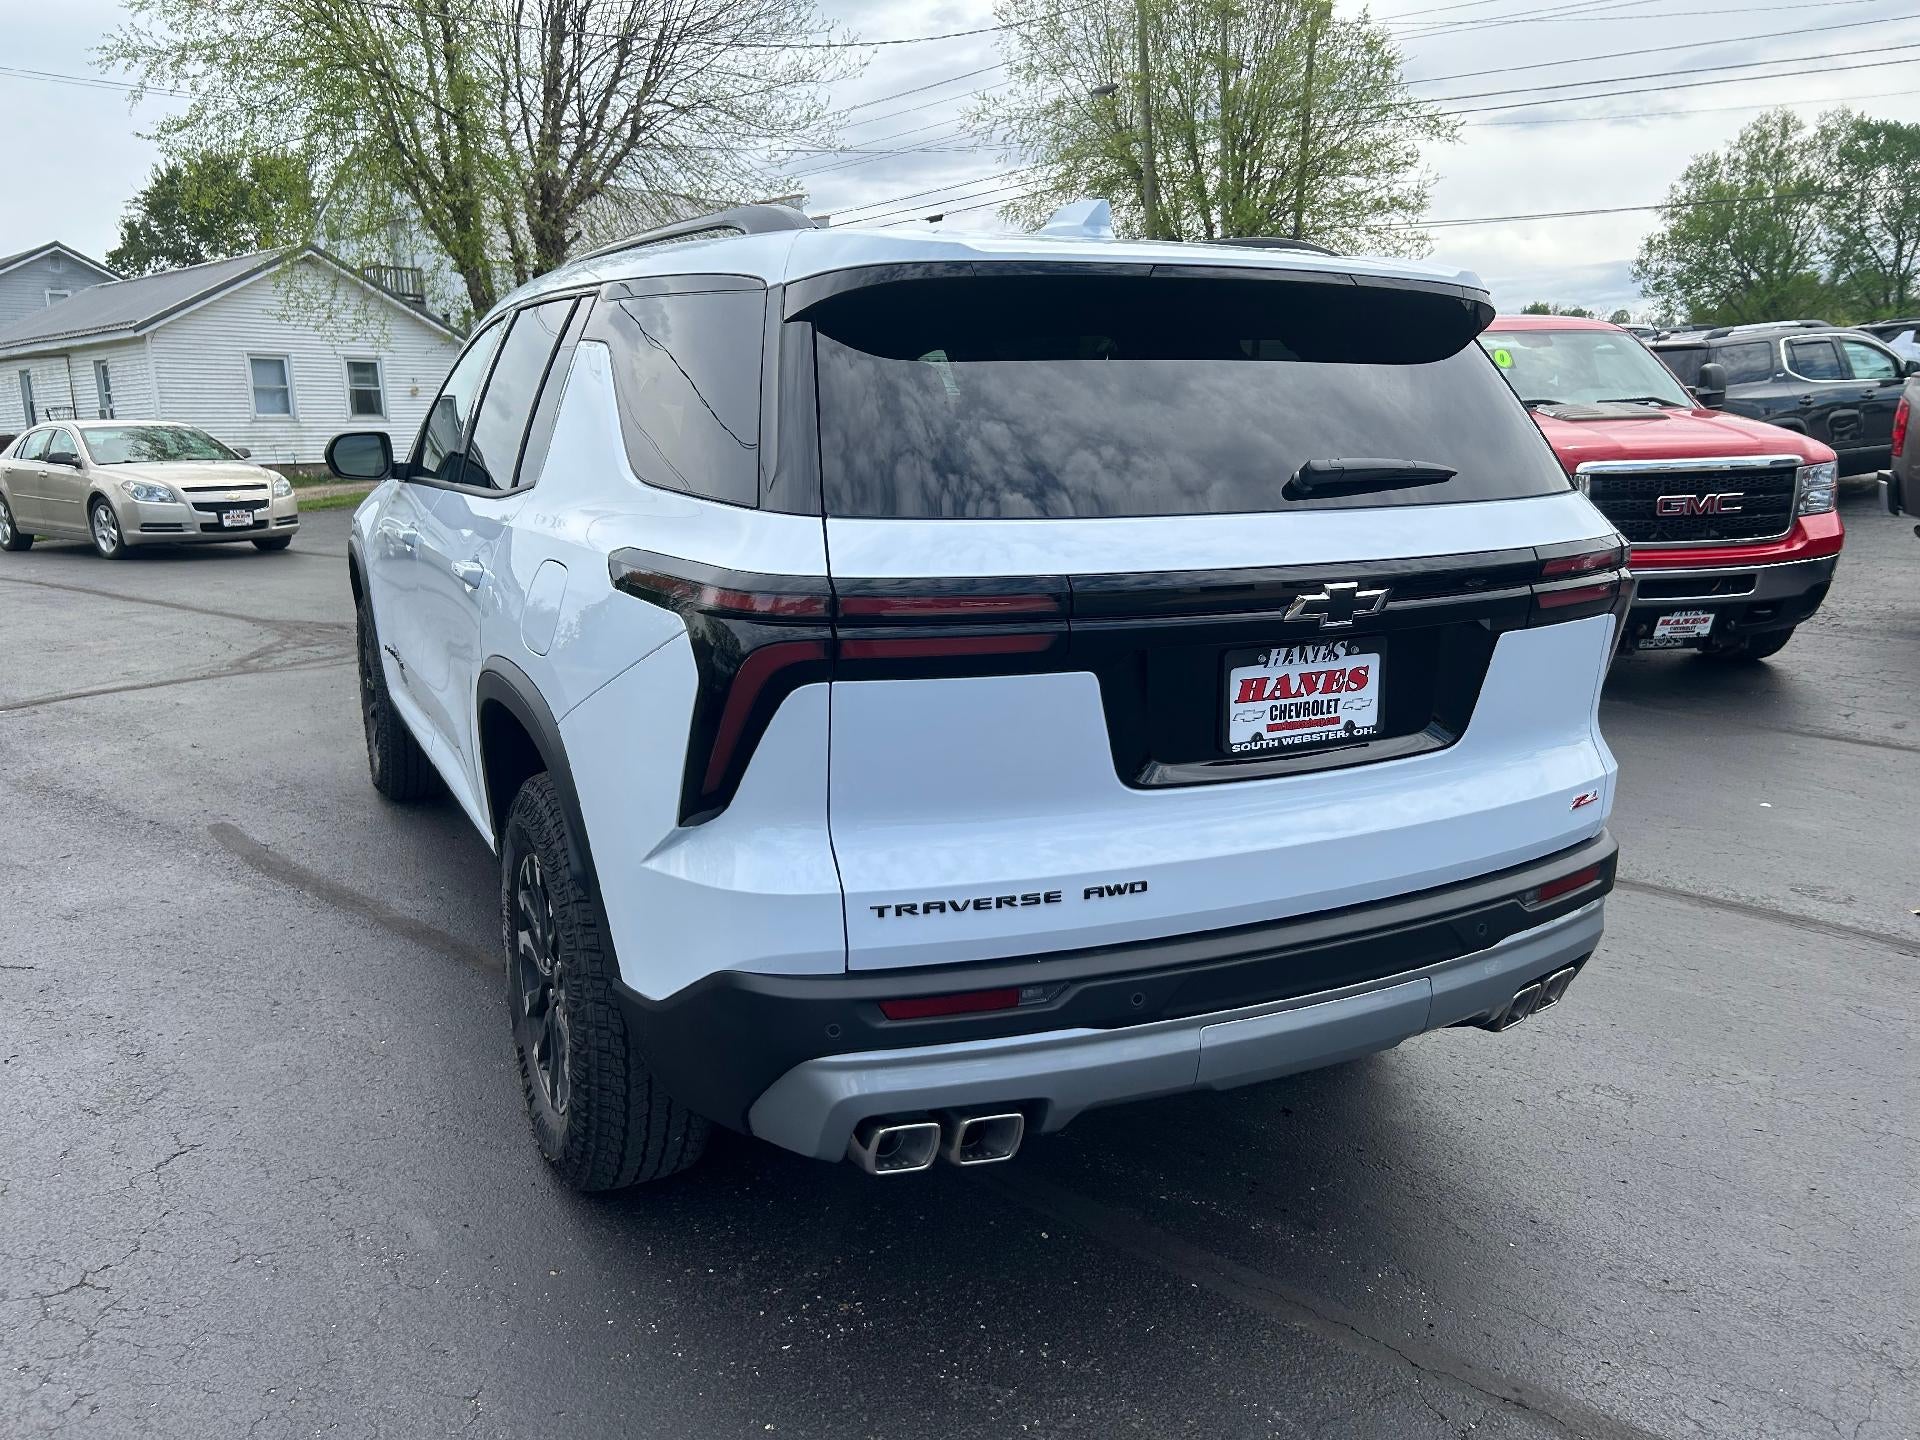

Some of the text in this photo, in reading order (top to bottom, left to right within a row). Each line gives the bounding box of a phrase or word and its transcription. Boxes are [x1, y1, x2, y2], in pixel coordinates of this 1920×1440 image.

[1657, 492, 1744, 517] GMC
[1234, 665, 1370, 704] HANES
[1269, 698, 1341, 721] CHEVROLET
[1231, 726, 1377, 753] SOUTH WEBSTER, OH.
[869, 880, 1148, 918] TRAVERSE AWD
